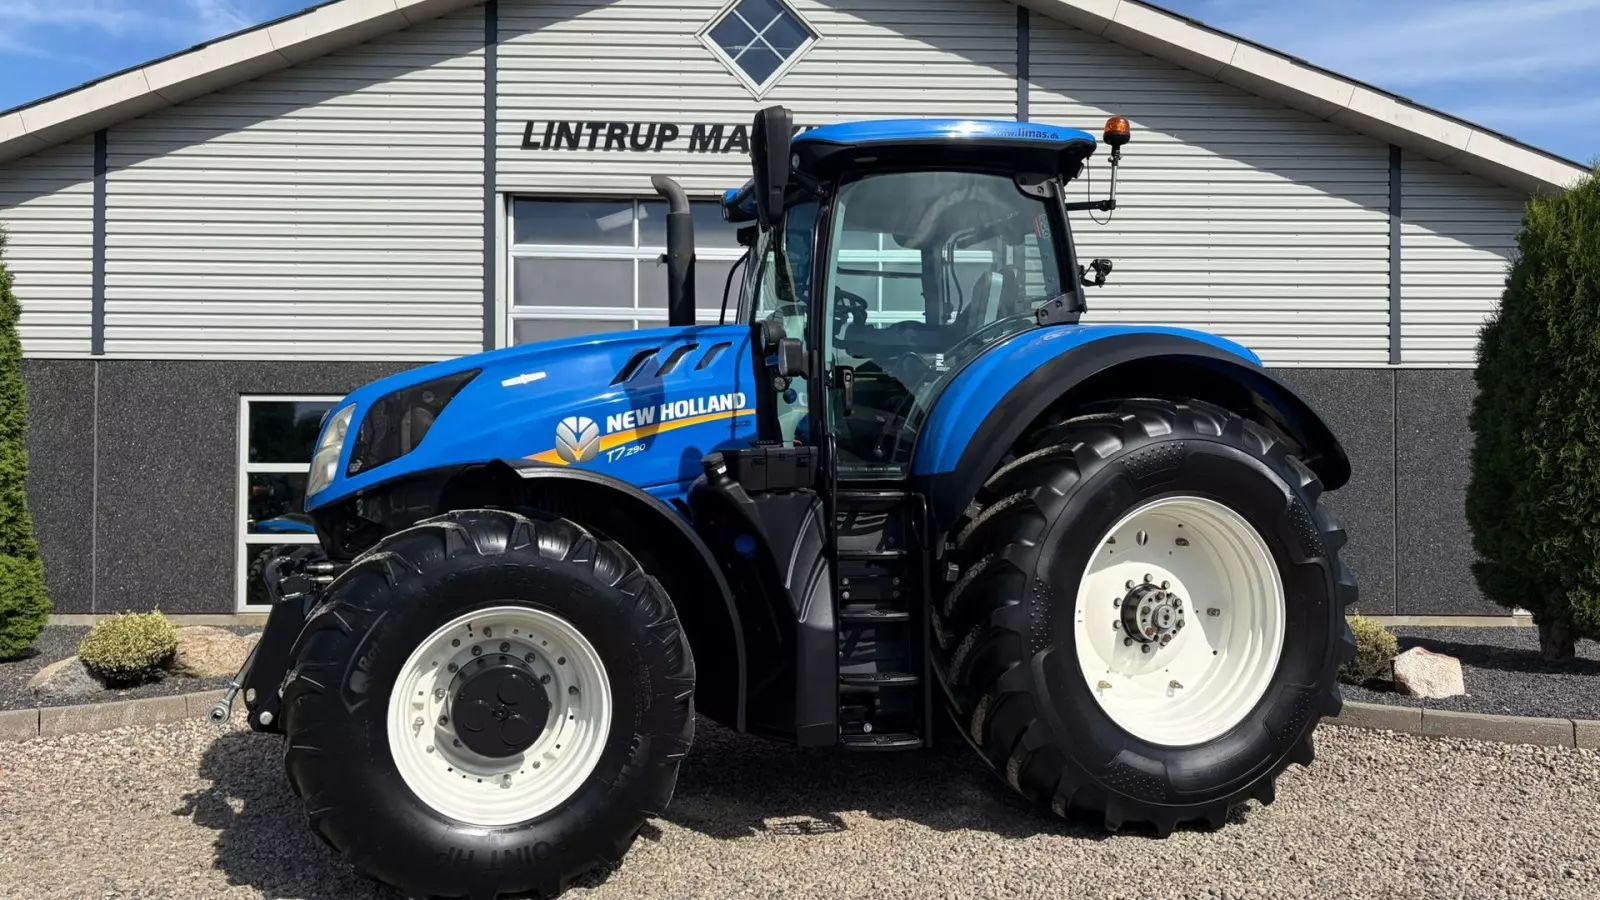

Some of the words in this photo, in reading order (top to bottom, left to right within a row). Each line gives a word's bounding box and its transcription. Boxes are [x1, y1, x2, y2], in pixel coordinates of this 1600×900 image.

[521, 121, 679, 152] LINTRUP
[606, 406, 656, 433] NEW
[660, 392, 746, 421] HOLLAND
